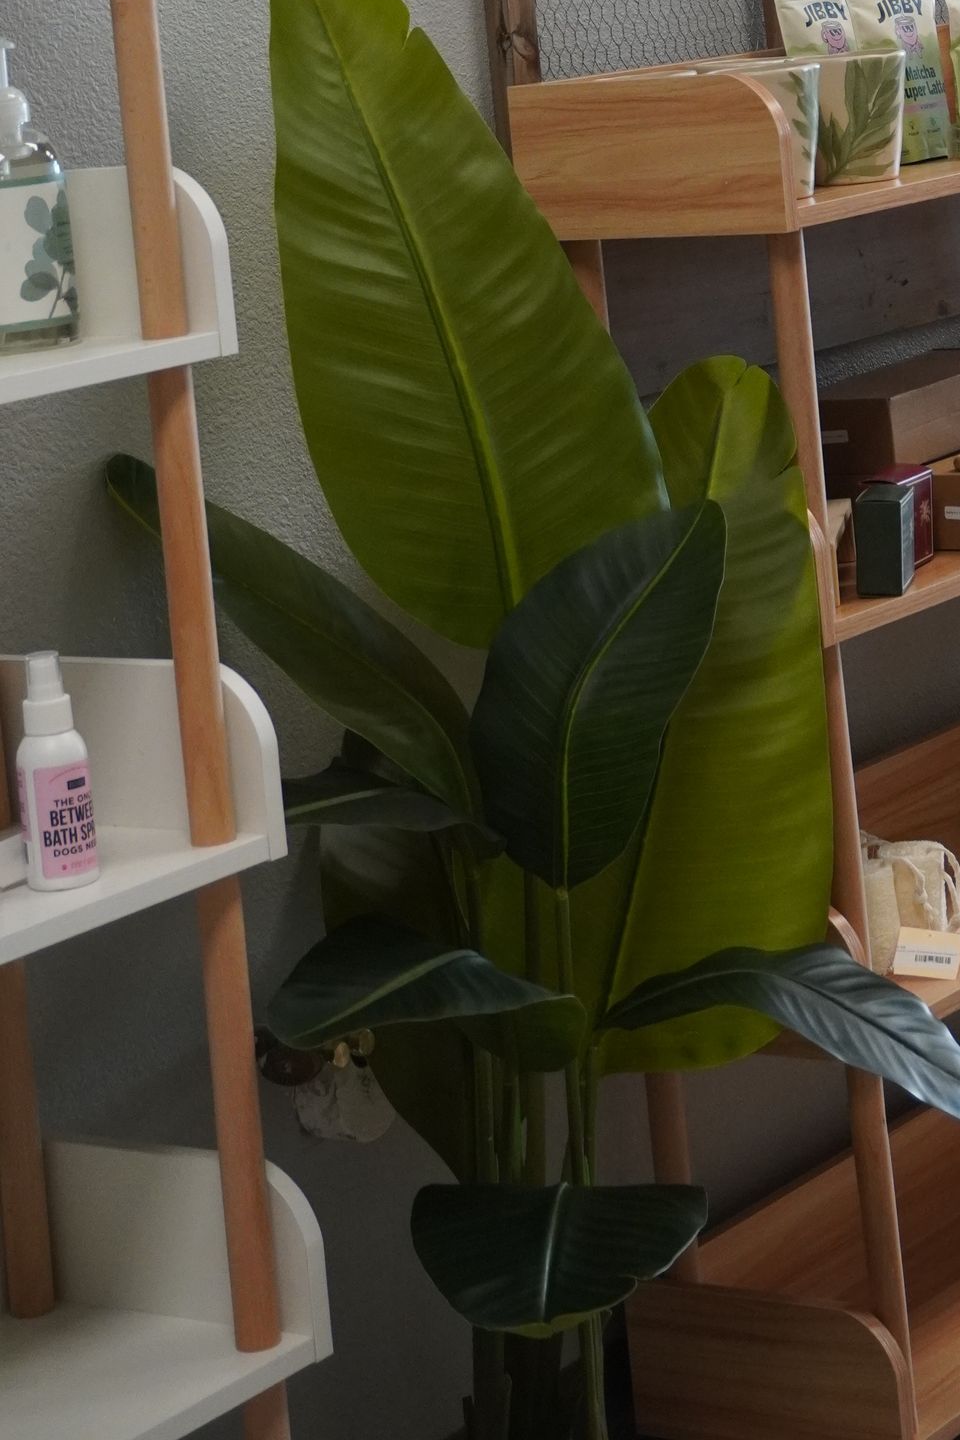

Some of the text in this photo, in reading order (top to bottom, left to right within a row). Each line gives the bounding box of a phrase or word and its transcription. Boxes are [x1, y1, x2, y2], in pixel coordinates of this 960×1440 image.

[803, 1, 848, 27] JIBBY
[905, 64, 936, 81] Matcha
[904, 86, 926, 101] uper
[54, 791, 92, 807] THE ONL
[50, 800, 94, 827] BETWEE
[43, 820, 96, 847] BATH SPR
[53, 839, 96, 857] DOGS NEE
